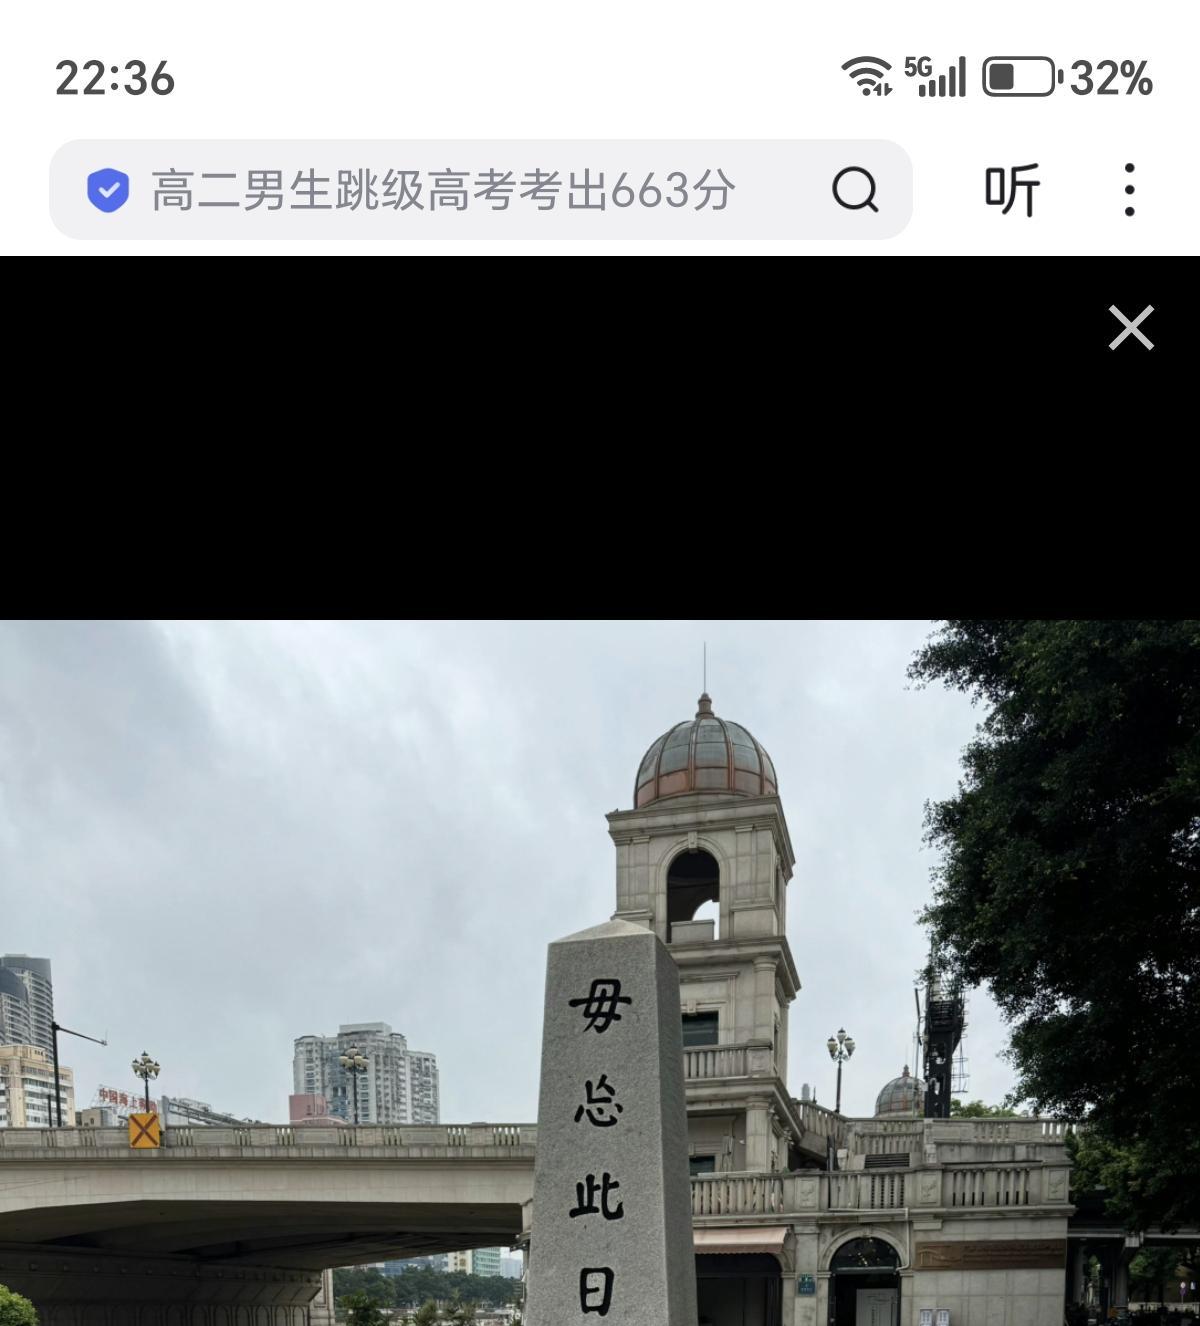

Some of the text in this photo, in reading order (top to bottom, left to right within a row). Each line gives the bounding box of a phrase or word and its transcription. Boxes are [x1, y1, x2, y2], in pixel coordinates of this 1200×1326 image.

[56, 60, 174, 95] 22:36
[904, 56, 933, 77] 5G
[1070, 60, 1153, 95] 32%
[151, 167, 736, 212] 高二男生跳级高考考出663分
[985, 163, 1041, 217] 听
